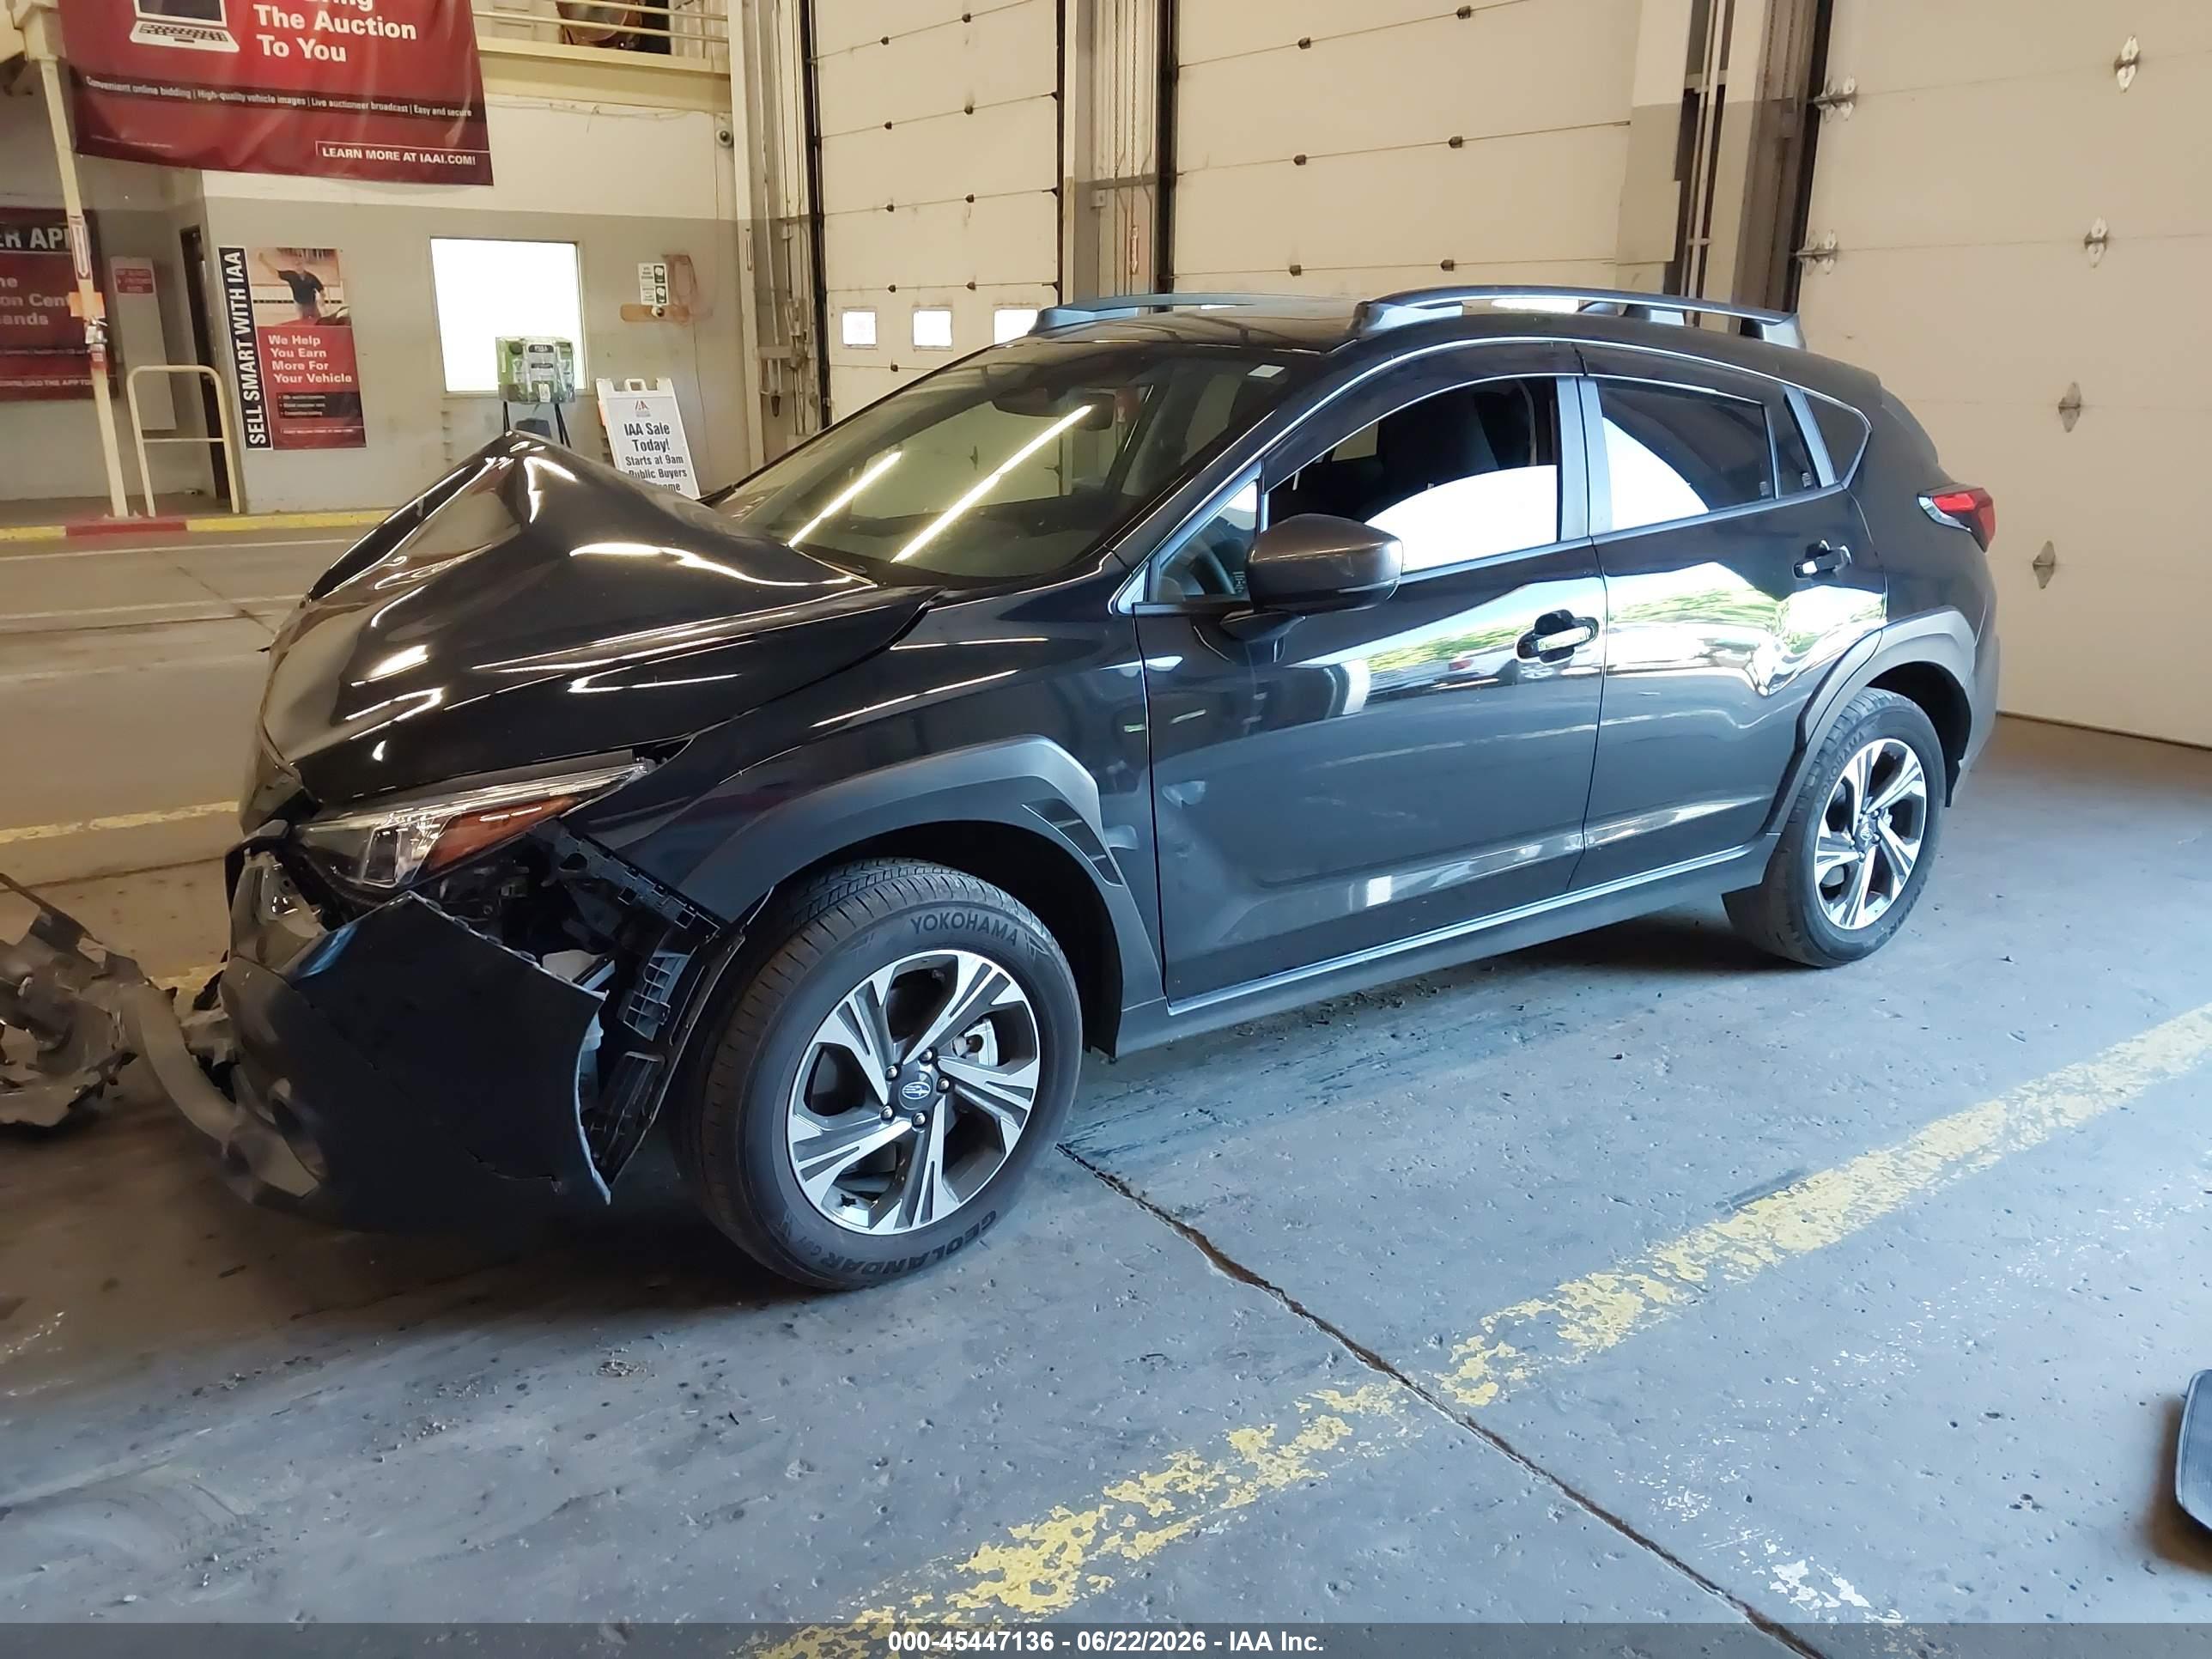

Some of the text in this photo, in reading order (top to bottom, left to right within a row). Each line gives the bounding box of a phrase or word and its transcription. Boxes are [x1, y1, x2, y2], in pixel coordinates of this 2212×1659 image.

[252, 4, 306, 29] The
[313, 10, 417, 40] Auction
[256, 34, 347, 62] To You
[246, 94, 276, 104] vehicle
[277, 95, 306, 106] images
[312, 97, 327, 107] Live
[371, 101, 408, 113] broadcast
[414, 105, 430, 116] Easy
[432, 106, 446, 116] and
[447, 108, 472, 118] secure
[322, 147, 476, 166] LEARN MORE AT IAAI.COM!
[224, 252, 266, 445] SELL SMART WITH IAA
[268, 335, 321, 347] We Help
[270, 348, 326, 357] You Earn
[271, 361, 329, 370] More For
[274, 373, 352, 383] Your Vehicle
[623, 422, 671, 436] IAA Sale
[632, 438, 671, 453] Today!
[625, 454, 684, 466] Starts at 9am
[658, 468, 687, 479] Buyers
[910, 912, 1018, 946] YOKOHAMA
[820, 1210, 997, 1275] GEOLANDAR
